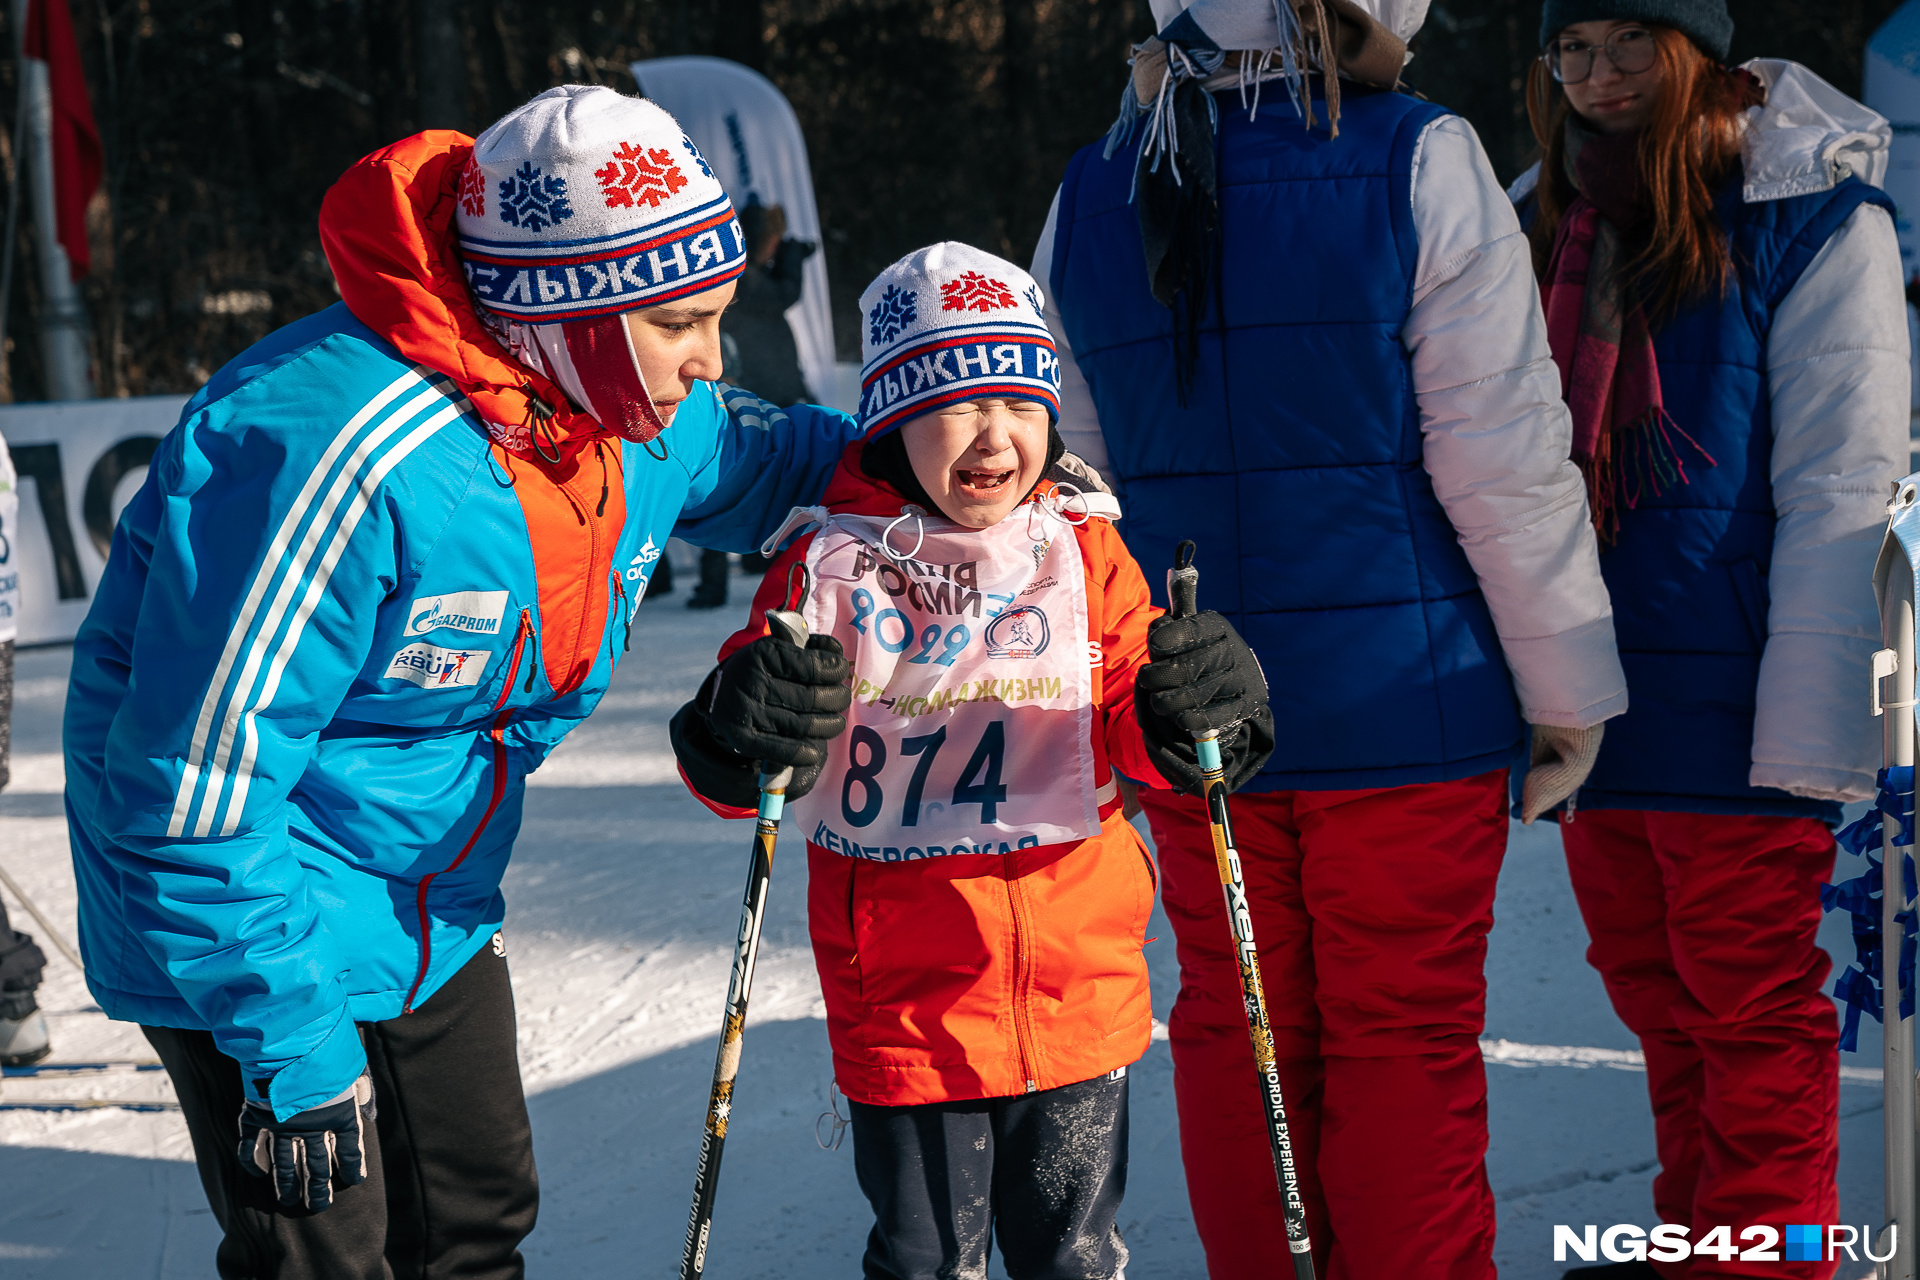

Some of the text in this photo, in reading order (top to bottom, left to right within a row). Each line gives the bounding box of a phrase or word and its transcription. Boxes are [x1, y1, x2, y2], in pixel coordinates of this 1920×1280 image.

[502, 228, 725, 304] ЛЫЖНЯ
[866, 344, 1023, 417] ЛЫЖНЯ
[433, 614, 497, 632] GAZPROM
[971, 676, 1061, 702] ЖИЗНИ
[841, 720, 1007, 828] 874
[1264, 1060, 1285, 1119] NORDIC
[1275, 1122, 1301, 1209] EXPERIENCE
